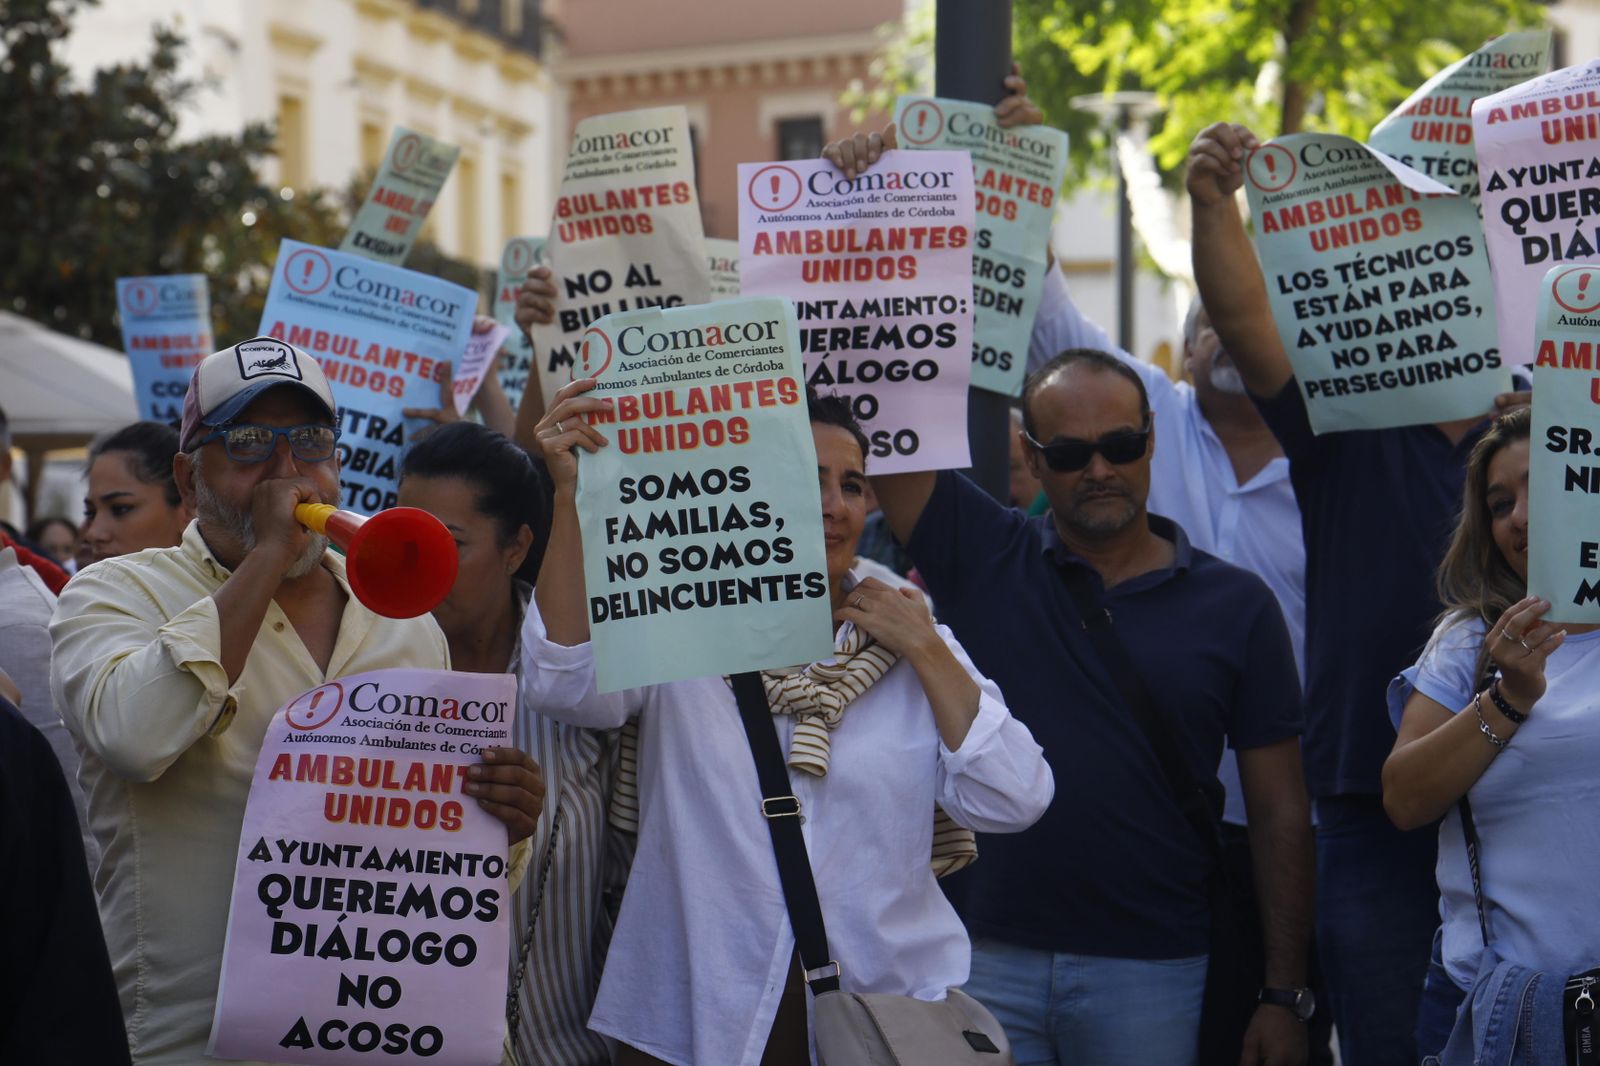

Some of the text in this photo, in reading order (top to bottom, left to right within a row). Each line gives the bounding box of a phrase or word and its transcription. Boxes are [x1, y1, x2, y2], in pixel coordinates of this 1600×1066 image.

[569, 127, 674, 158] omacor
[948, 112, 1055, 159] Comacor
[1541, 113, 1600, 145] UNI
[807, 170, 954, 196] Comacor
[1262, 185, 1320, 205] Autónomos
[1323, 173, 1383, 192] Ambulantes
[1303, 162, 1359, 181] Asociación
[1360, 161, 1373, 171] de
[553, 181, 691, 219] BULANTES
[757, 206, 955, 224] Autónomos Ambulantes de Córdoba
[806, 192, 957, 209] Asociación de Comerciantes
[557, 213, 654, 243] UNIDOS
[753, 225, 968, 256] AMBULANTES
[1309, 207, 1423, 252] UNIDOS
[563, 263, 662, 299] NO AL
[801, 255, 917, 284] UNIDOS
[1277, 235, 1474, 295] LOS TÉCNICOS
[335, 265, 460, 318] Comacor
[1293, 267, 1471, 321] ESTÁN PARA
[617, 320, 779, 356] Comacor
[1297, 295, 1483, 349] AYUDARNOS,
[268, 320, 452, 387] AMBULANTES
[618, 344, 784, 373] Asociación de Comerciantes
[1331, 329, 1458, 370] NO PARA
[1535, 340, 1600, 371] AM
[316, 357, 405, 398] NIDOS
[640, 368, 712, 386] Ambulantes
[715, 365, 730, 377] de
[734, 359, 784, 375] Córdoba
[1304, 348, 1502, 400] PERSEGUIRNOS
[577, 376, 799, 425] MBULANTES
[617, 416, 750, 454] UNIDOS
[868, 428, 919, 457] SO
[619, 466, 751, 504] SOMOS
[605, 501, 785, 545] FAMILIAS,
[606, 537, 794, 583] NO SOMOS
[590, 572, 827, 624] DELINCUENTES
[348, 682, 508, 724] Comacor
[283, 731, 356, 746] Autónomos
[359, 735, 436, 752] Ambulantes
[440, 741, 456, 753] de
[340, 715, 507, 739] Asociación de Comerciantes
[324, 792, 464, 832] UNIDOS
[257, 873, 500, 923] QUEREMOS
[270, 912, 477, 967] DIÁLOGO
[337, 972, 402, 1009] NO
[279, 1016, 444, 1057] ACOSO
